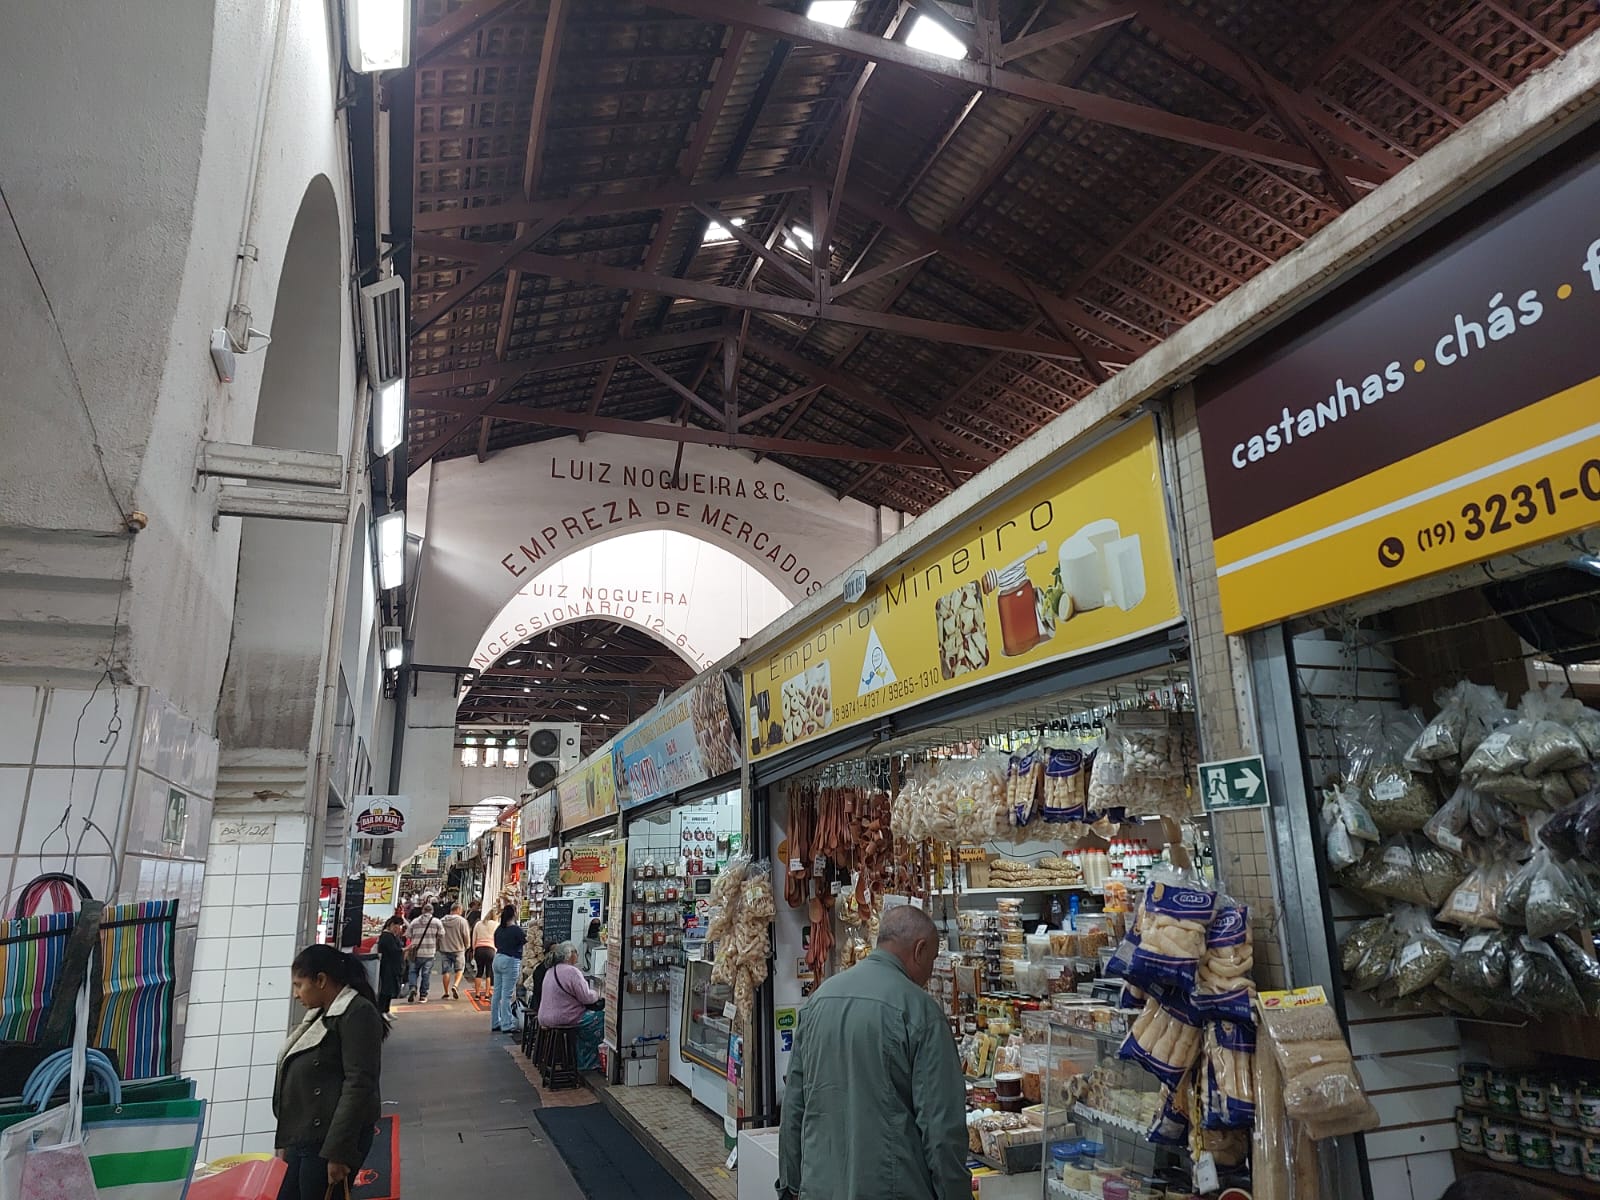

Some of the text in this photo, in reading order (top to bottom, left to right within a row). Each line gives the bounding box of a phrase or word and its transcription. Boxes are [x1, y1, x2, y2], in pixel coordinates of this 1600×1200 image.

[1435, 291, 1543, 366] chás
[551, 457, 611, 484] LUIZ
[623, 466, 746, 498] NOGUEIRA
[500, 497, 642, 578] EMPREZA
[655, 500, 691, 518] DE
[1417, 520, 1456, 552] (19)
[582, 587, 688, 606] NOGUEIRA
[769, 499, 1054, 682] Empório Mineiro
